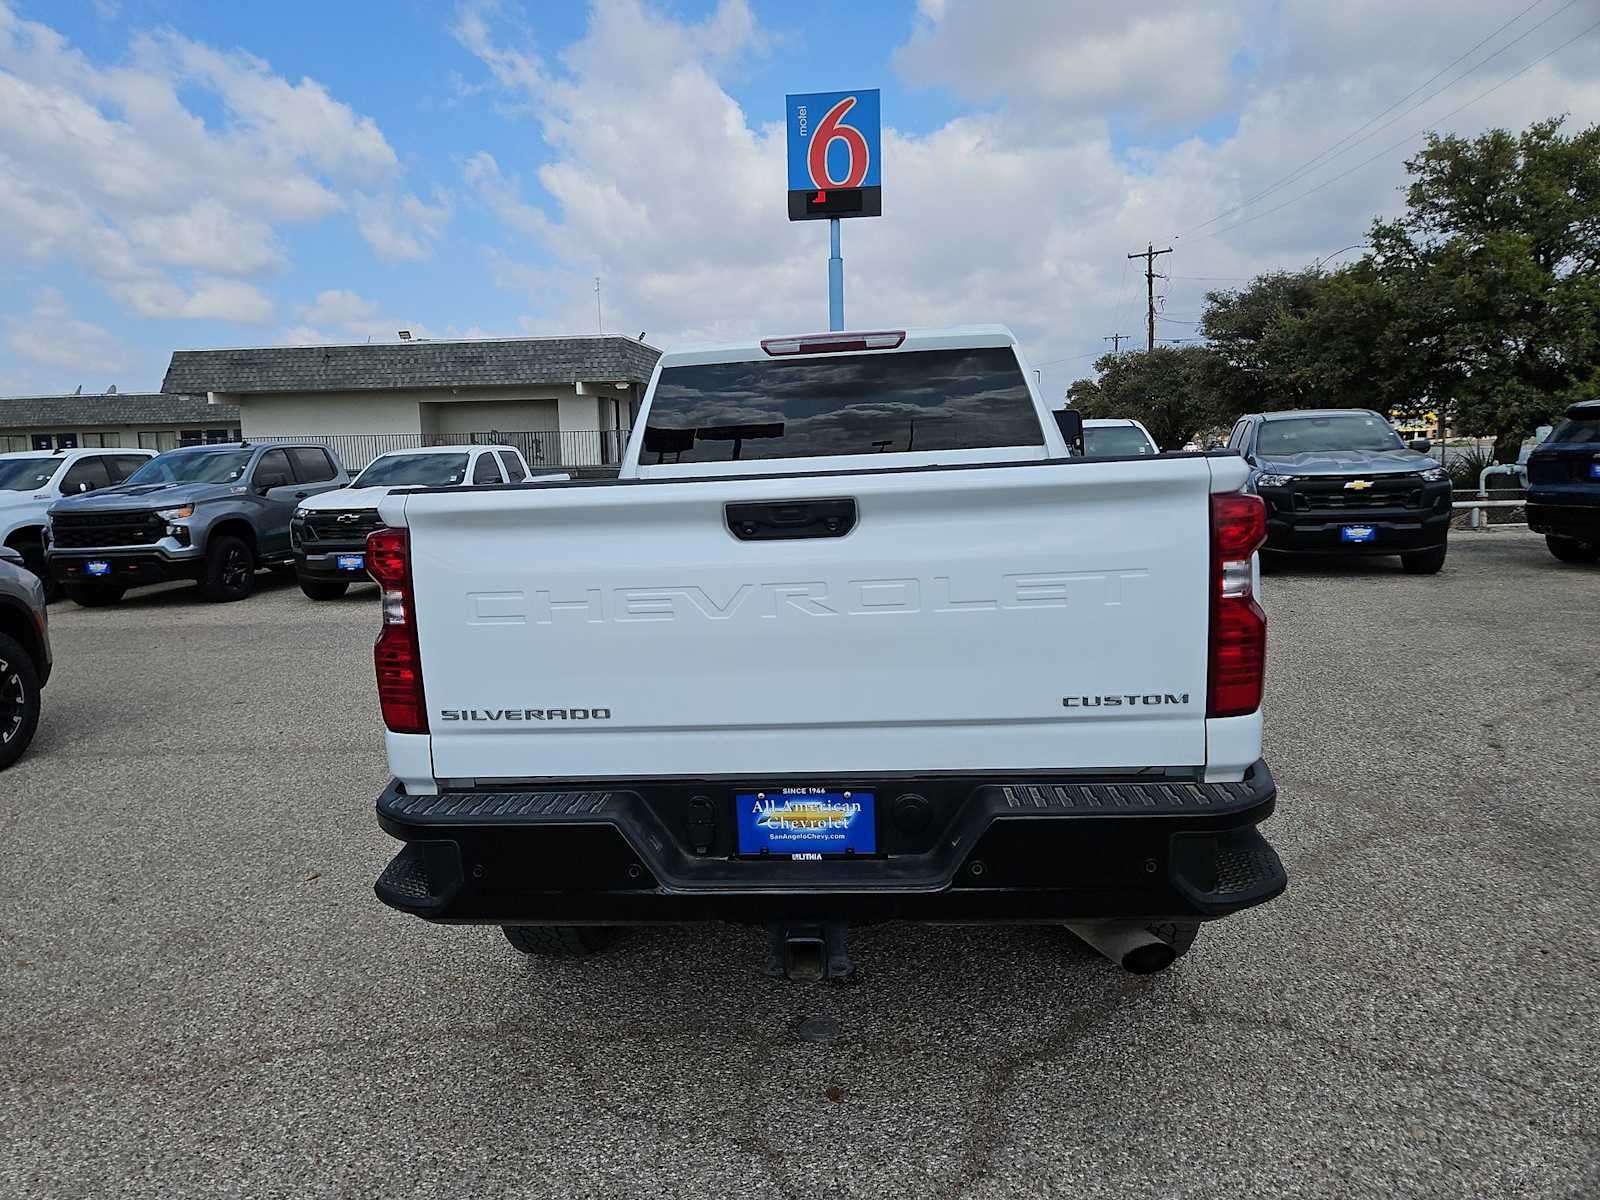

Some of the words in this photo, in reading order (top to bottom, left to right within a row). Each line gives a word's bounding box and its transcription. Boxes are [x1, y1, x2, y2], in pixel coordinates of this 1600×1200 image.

[797, 105, 808, 137] motel
[807, 96, 870, 188] 6
[465, 566, 1149, 627] CHEVROLET
[1062, 693, 1190, 707] CUSTOM
[440, 708, 611, 721] SILVERADO
[782, 787, 807, 795] SINCE
[752, 799, 776, 813] All
[783, 799, 862, 812] American
[767, 815, 850, 830] Chevrolet
[769, 833, 846, 841] SanAngeloChevy.com
